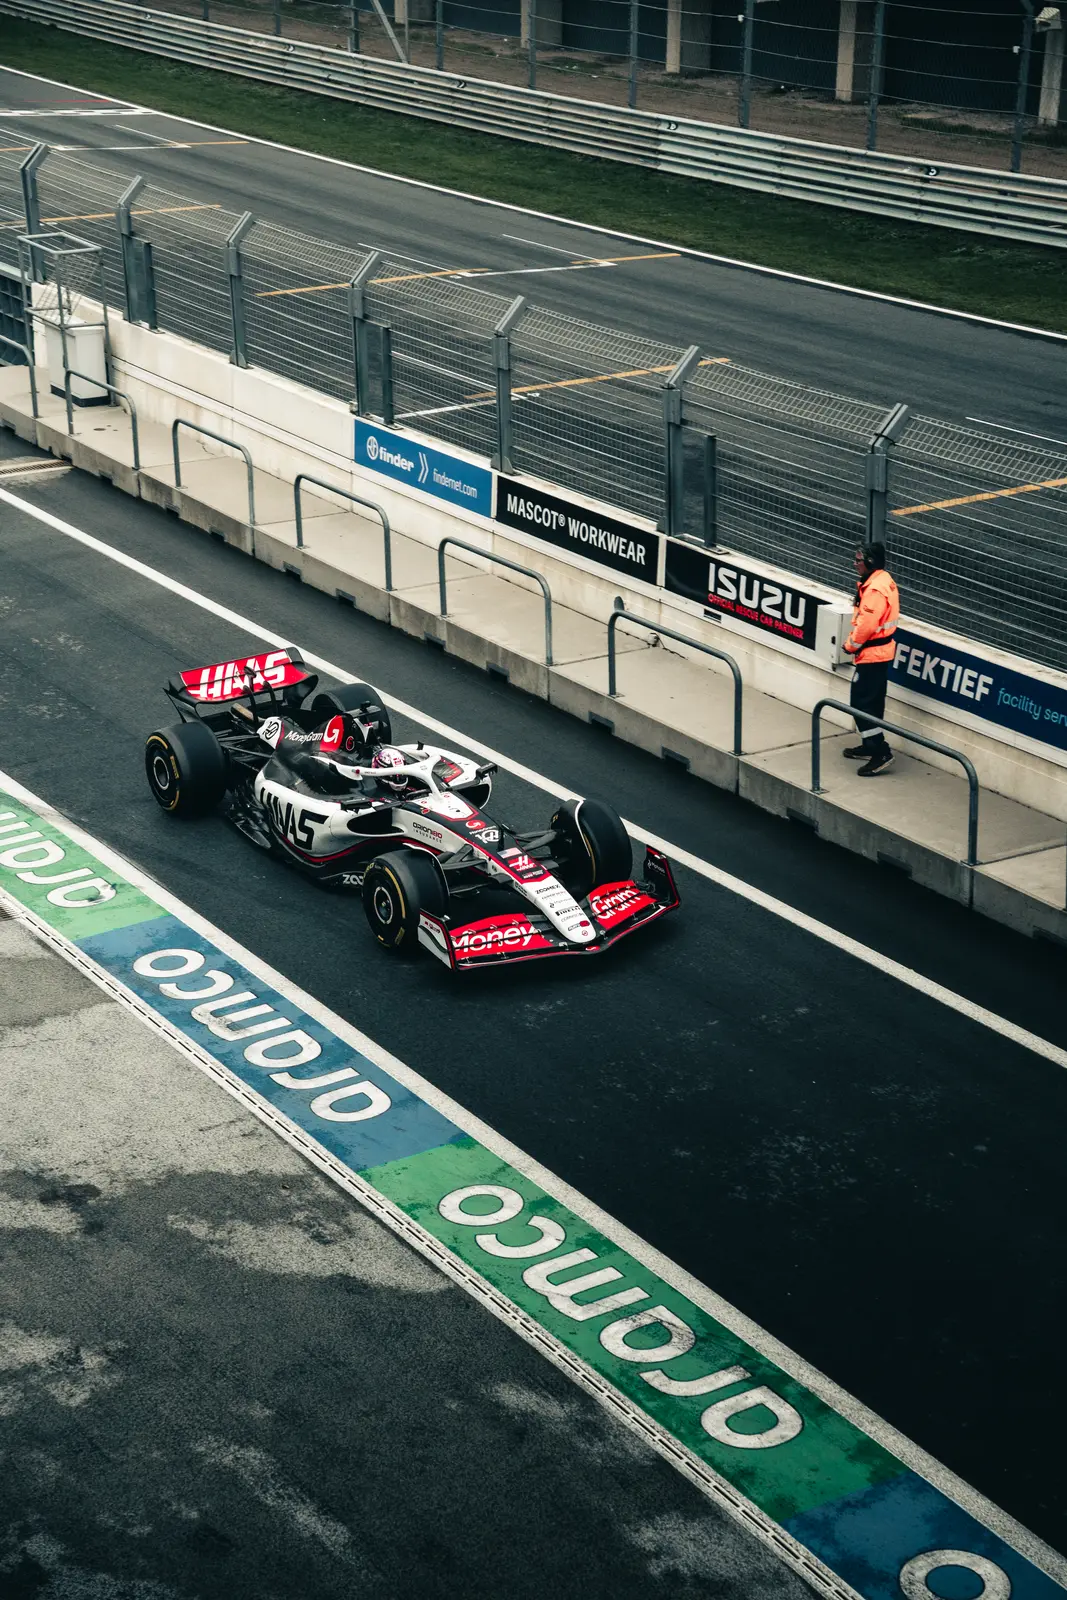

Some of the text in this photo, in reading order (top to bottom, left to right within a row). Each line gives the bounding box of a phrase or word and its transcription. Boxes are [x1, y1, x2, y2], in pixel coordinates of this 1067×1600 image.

[379, 446, 415, 472] finder
[433, 468, 478, 499] findernet.com
[568, 519, 647, 565] WORKWEAR
[707, 562, 806, 627] ISUZU
[707, 593, 805, 640] OFFICIAL RESCUE CAR PARTNER
[188, 651, 288, 699] HAAS
[997, 687, 1043, 720] facility
[284, 730, 324, 745] MoneyGram
[591, 888, 641, 921] Gram
[452, 923, 538, 953] Money
[132, 948, 392, 1123] aramco
[438, 1183, 804, 1450] aramco
